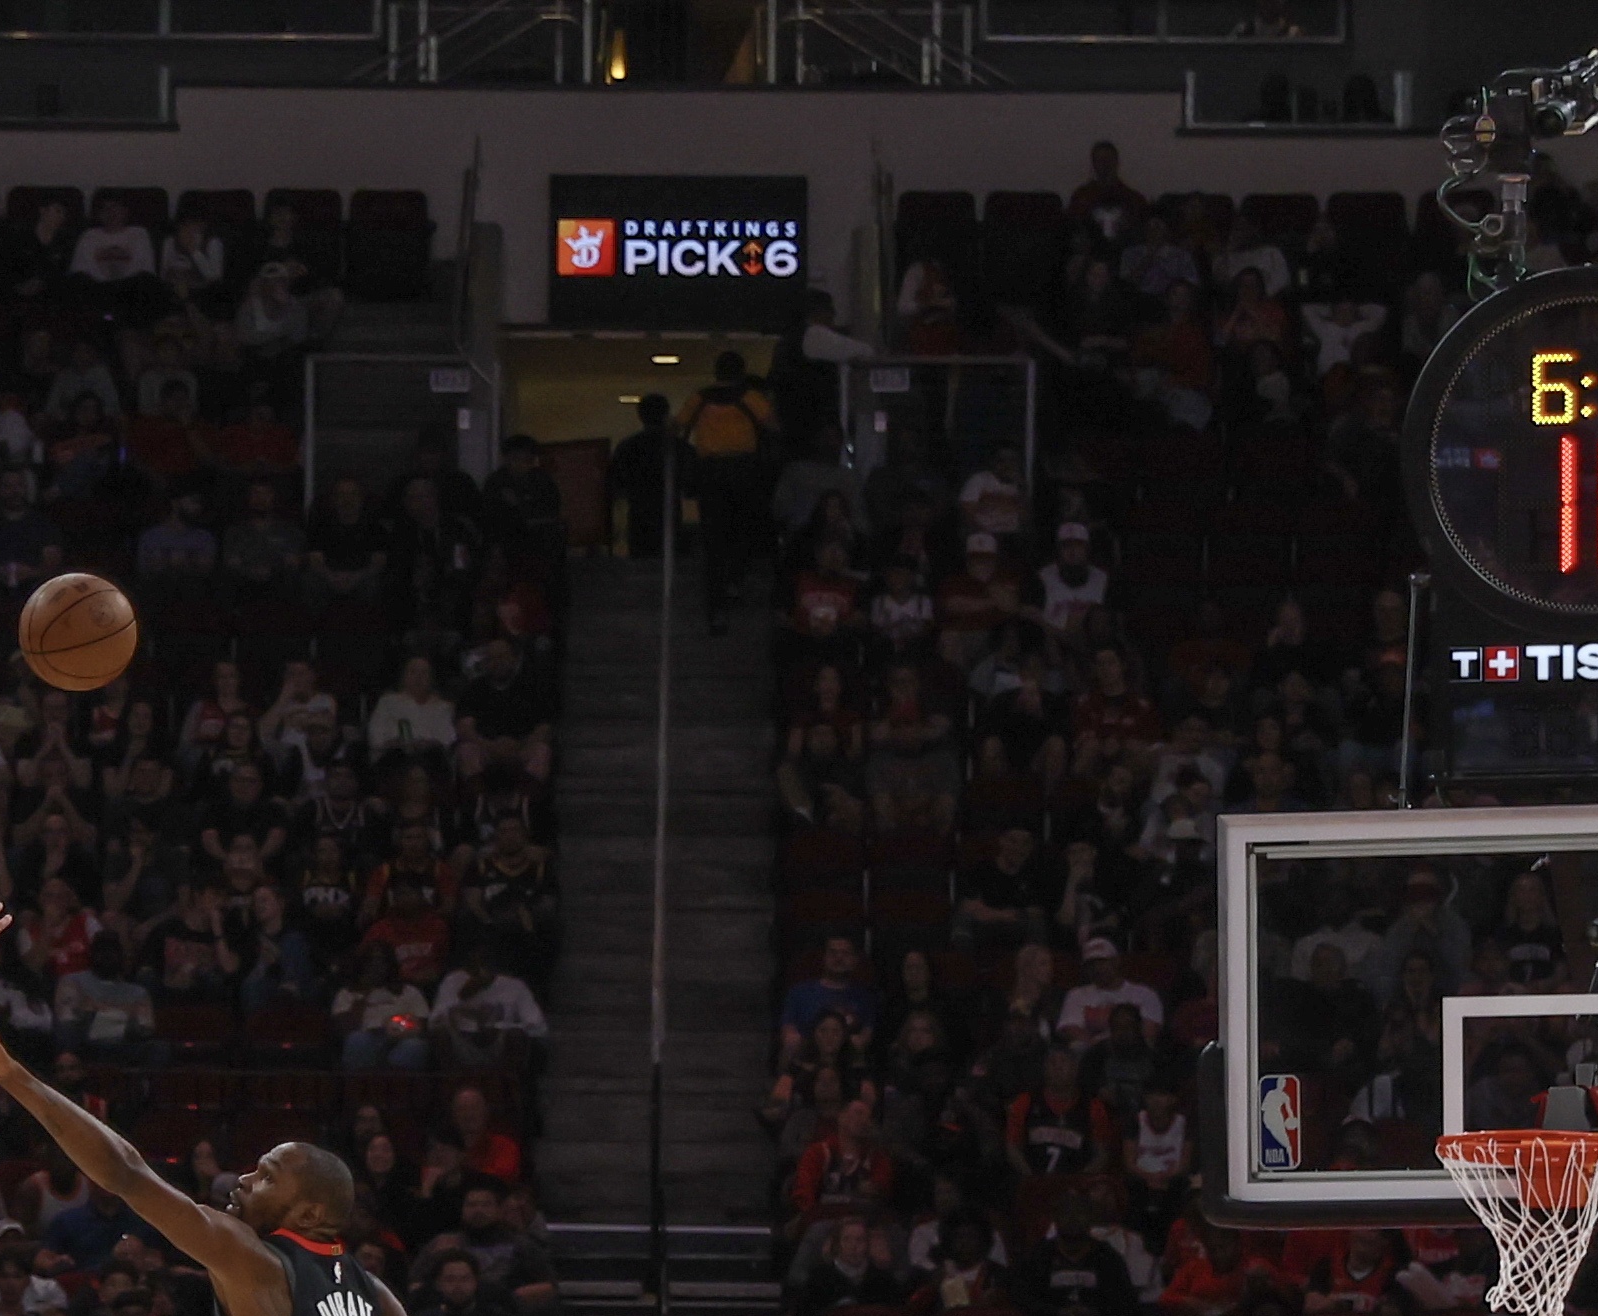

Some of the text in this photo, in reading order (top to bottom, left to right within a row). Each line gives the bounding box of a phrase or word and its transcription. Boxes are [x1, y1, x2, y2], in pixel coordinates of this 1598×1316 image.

[623, 219, 799, 238] DRAFTKINGS
[623, 239, 800, 278] PICK 6
